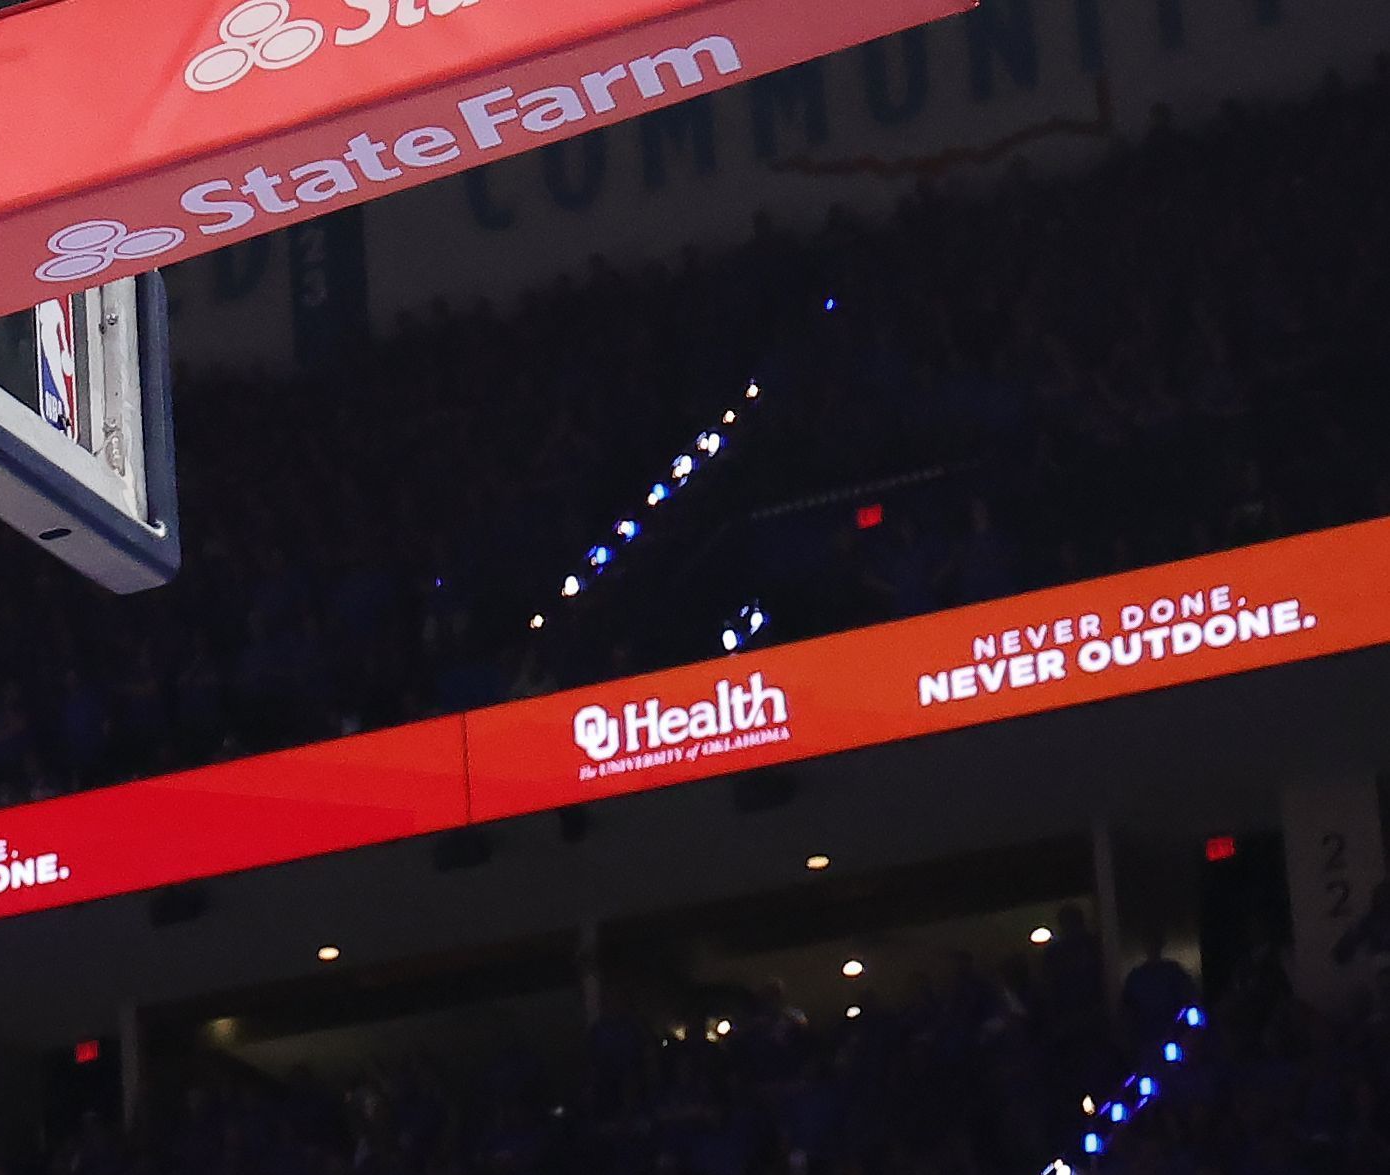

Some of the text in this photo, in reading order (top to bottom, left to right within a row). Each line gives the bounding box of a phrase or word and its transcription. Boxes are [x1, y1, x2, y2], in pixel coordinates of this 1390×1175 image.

[918, 598, 1318, 706] NEVER OUTDONE.
[971, 584, 1247, 660] NEVER DONE.
[622, 671, 789, 752] Health
